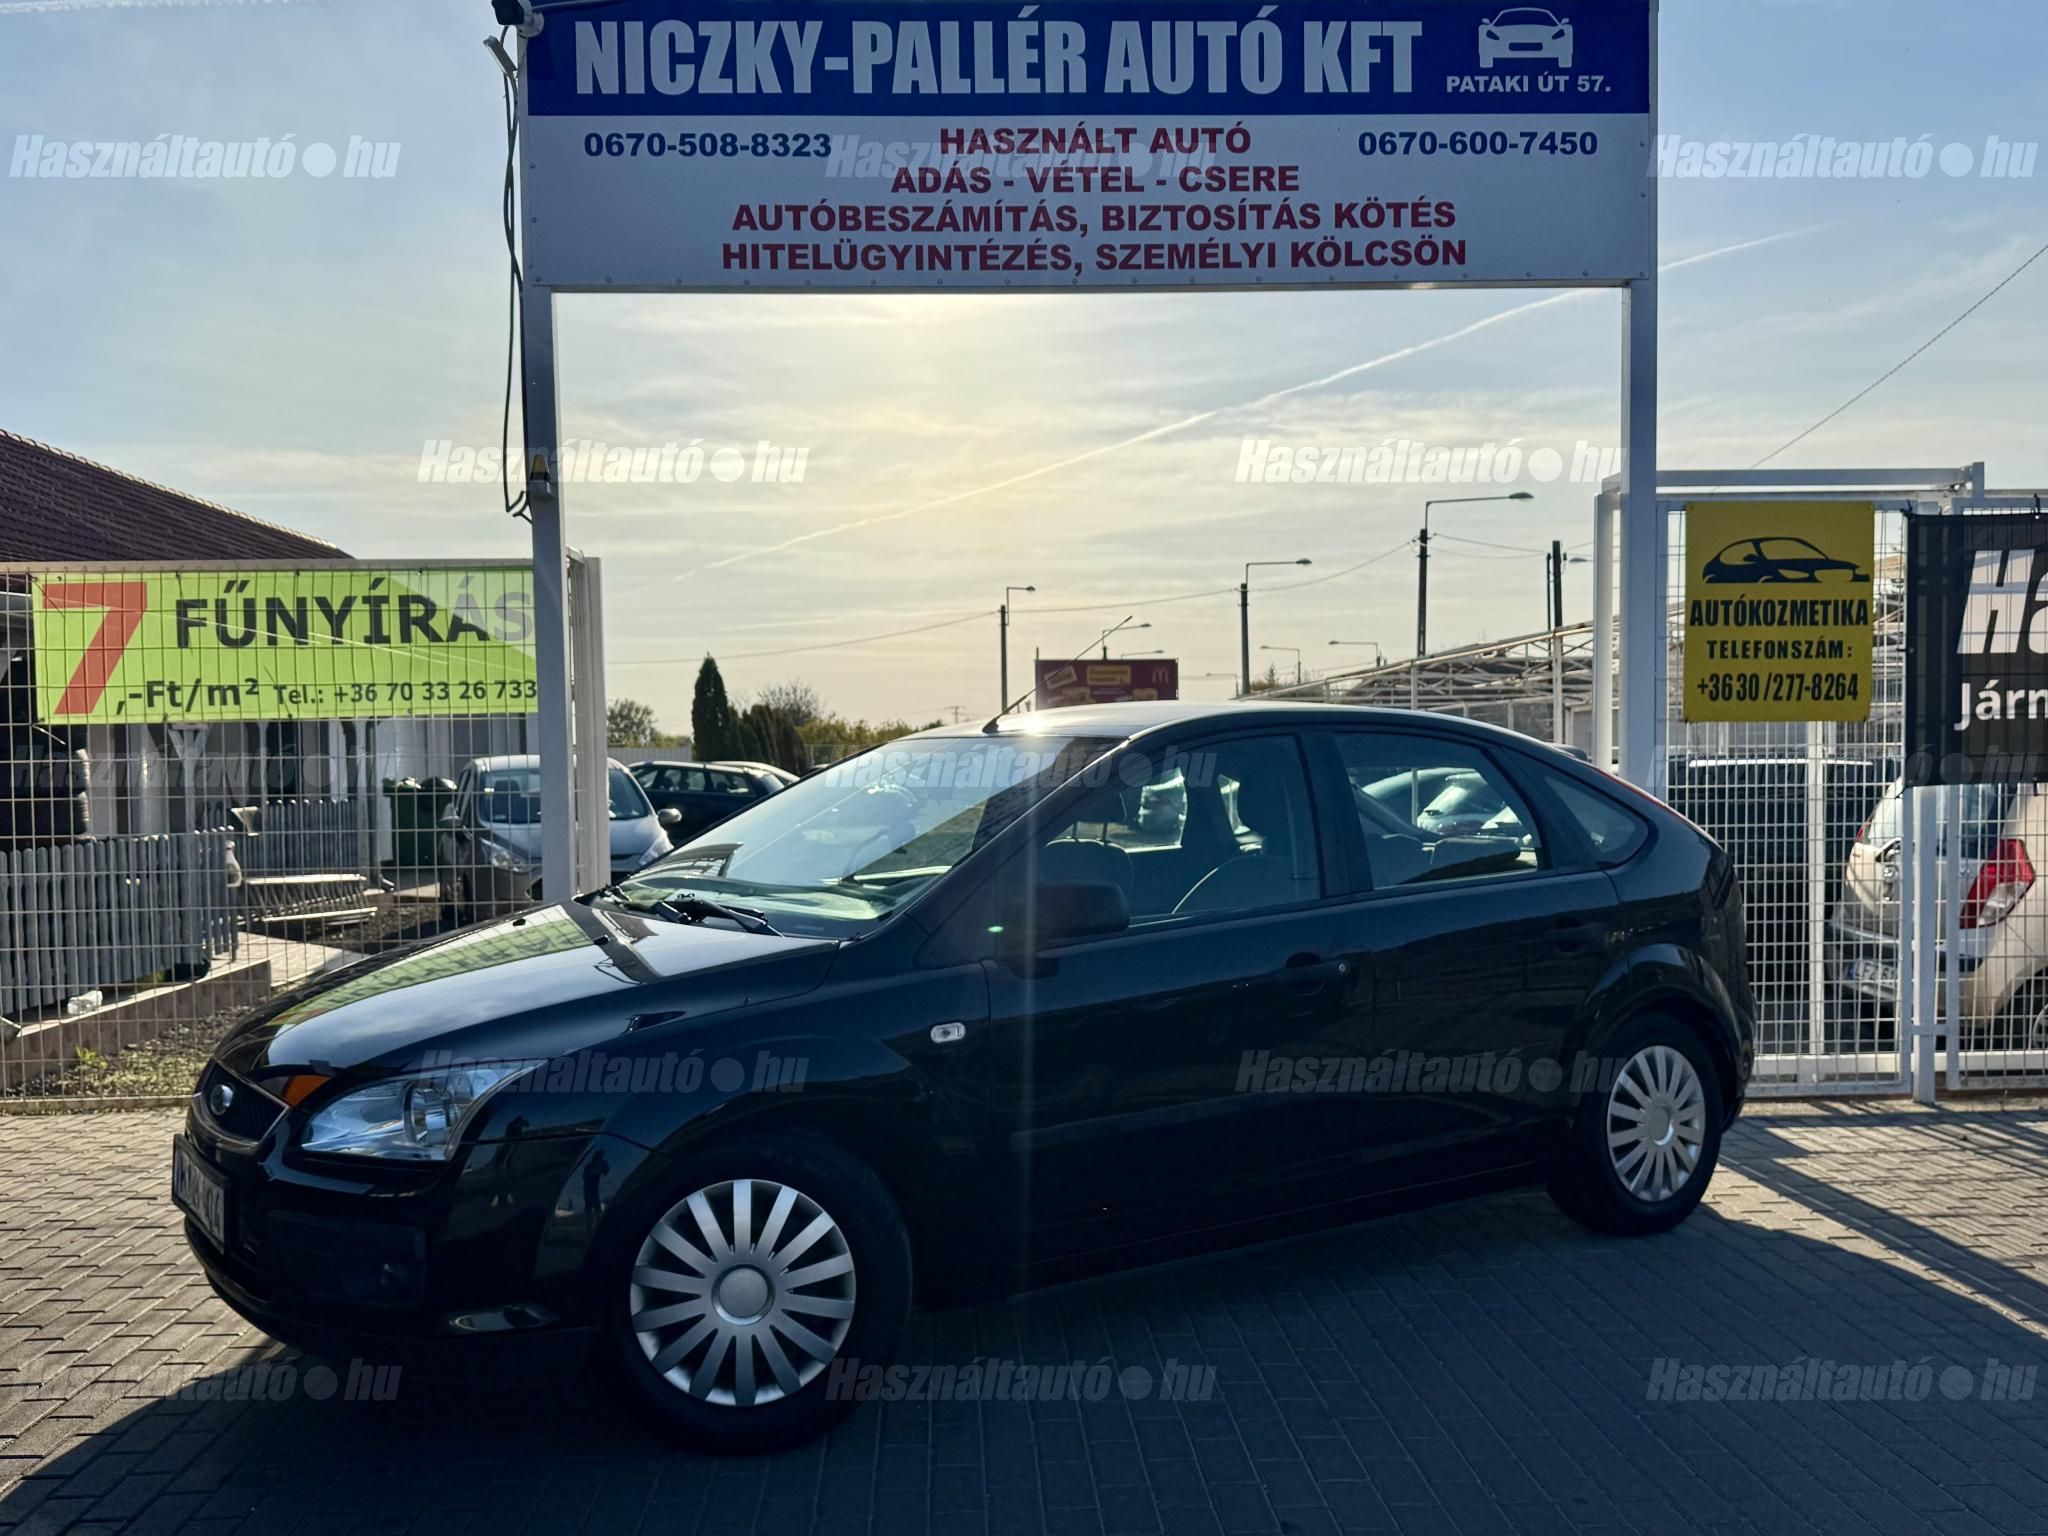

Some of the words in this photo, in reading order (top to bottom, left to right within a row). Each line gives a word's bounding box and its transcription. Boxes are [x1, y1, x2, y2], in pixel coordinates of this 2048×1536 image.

[575, 5, 1088, 95] NICZKY-PALLÉR
[1104, 5, 1283, 95] AUTÓ
[1304, 20, 1422, 94] KFT
[1446, 76, 1529, 93] PATAKI
[1538, 72, 1568, 93] ÚT
[1577, 76, 1611, 93] 57.
[584, 133, 832, 157] 0670-508-8323
[941, 121, 1137, 154] HASZNÁLT
[1150, 121, 1251, 154] AUTÓ
[1358, 131, 1598, 156] 0670-600-7450
[891, 161, 992, 193] ADÁS
[1026, 160, 1144, 193] VÉTEL
[1178, 166, 1299, 192] CSERE
[732, 199, 1088, 237] AUTÓBESZÁMÍTÁS,
[1102, 199, 1321, 231] BIZTOSÍTÁS
[1333, 196, 1456, 228] KÖTÉS
[723, 238, 1082, 276] HITELÜGYINTÉZÉS,
[1096, 237, 1275, 270] SZEMÉLYI
[1290, 235, 1466, 268] KÖLCSÖN
[176, 576, 534, 650] FŰNYÍRÁS
[1689, 594, 1869, 628] AUTÓKOZMETIKA
[42, 581, 147, 714] 7
[273, 684, 324, 705] Tel.:
[334, 683, 377, 704] +36
[387, 682, 413, 702] 70
[423, 681, 449, 701] 33
[459, 680, 486, 700] 26
[495, 678, 537, 699] 733
